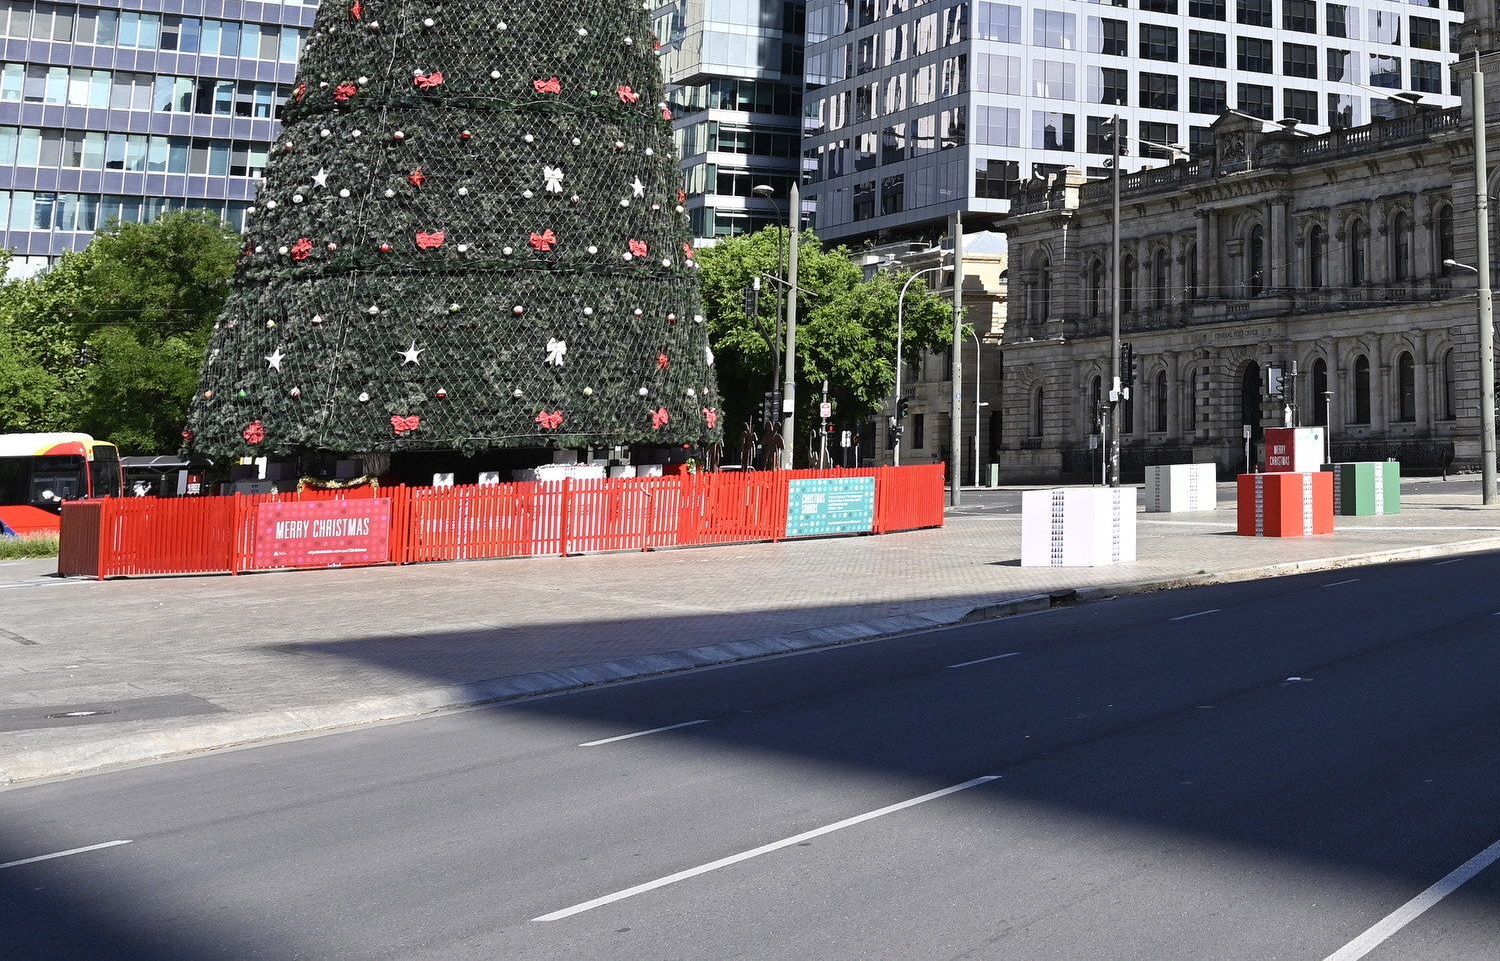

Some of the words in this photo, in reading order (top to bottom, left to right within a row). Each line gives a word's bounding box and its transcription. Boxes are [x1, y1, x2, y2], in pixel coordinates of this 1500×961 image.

[1273, 444, 1286, 455] MERRY
[1269, 456, 1290, 466] CHRISTMAS
[276, 520, 310, 539] MERRY
[313, 518, 370, 538] CHRISTMAS
